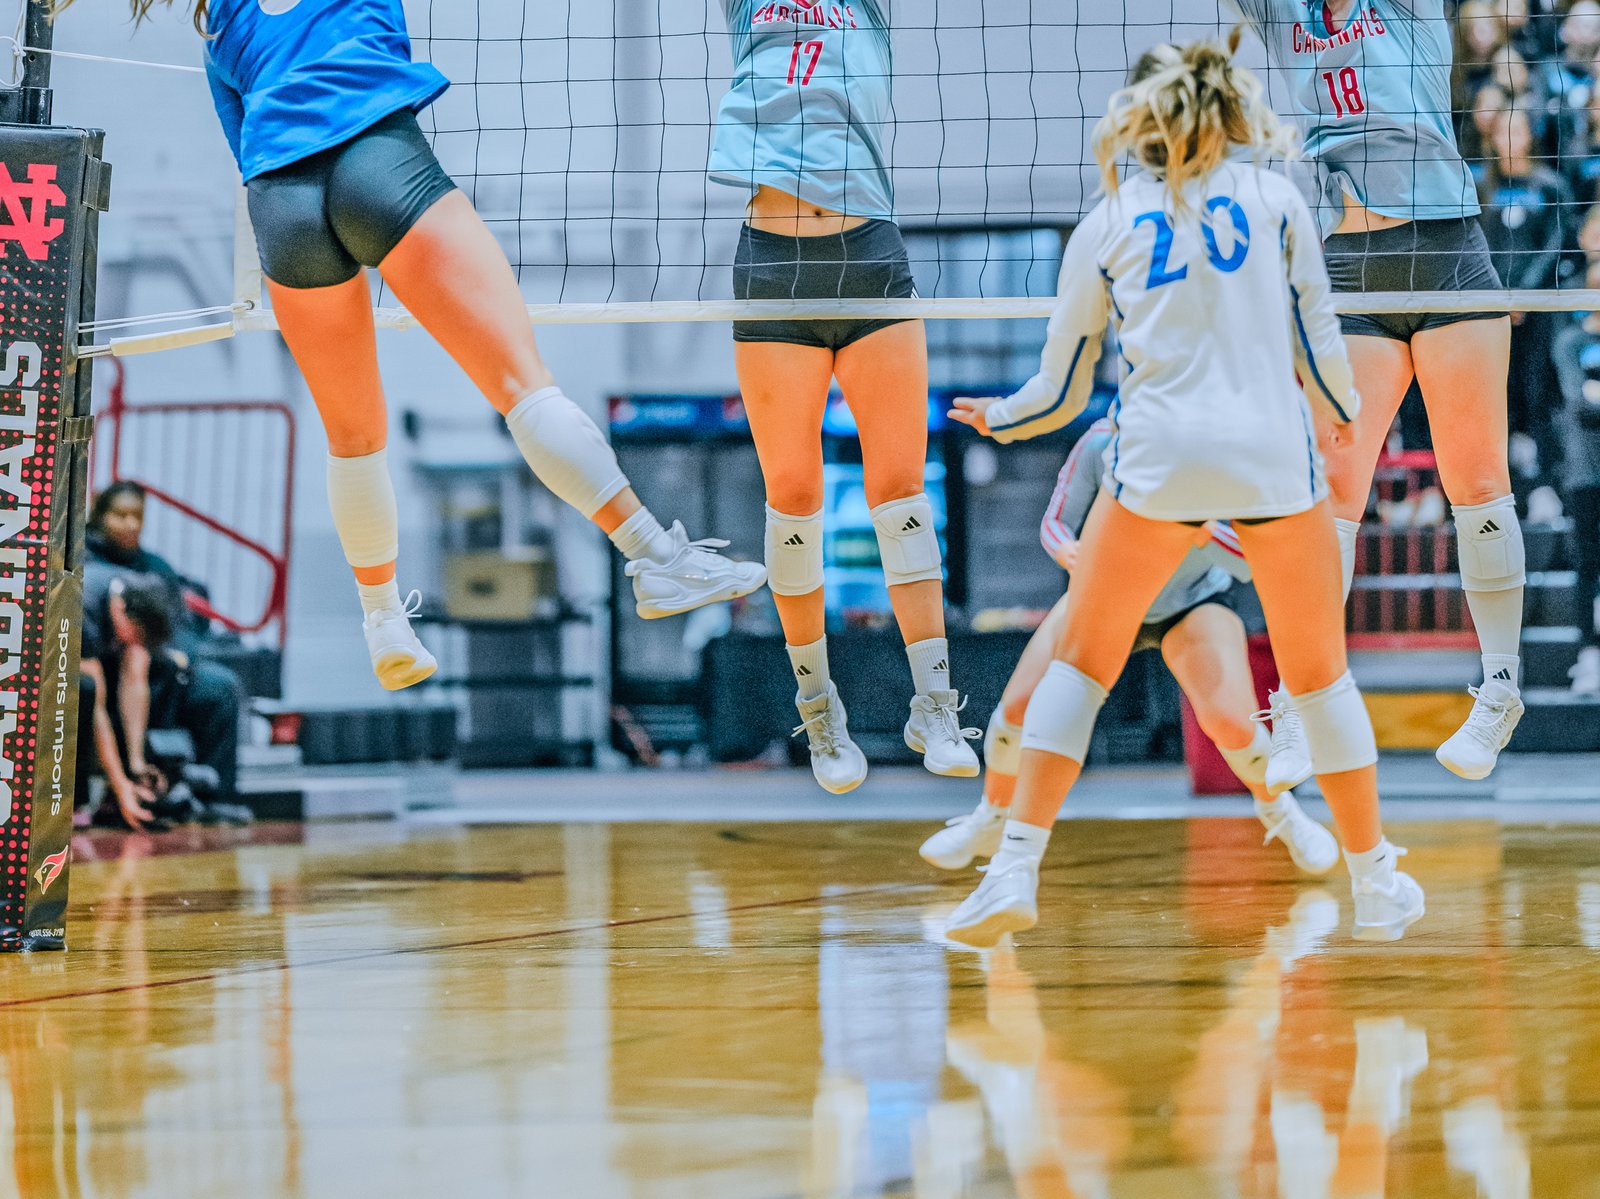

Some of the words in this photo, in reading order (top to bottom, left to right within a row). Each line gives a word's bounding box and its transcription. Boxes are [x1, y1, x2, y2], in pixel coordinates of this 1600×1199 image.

[786, 40, 823, 86] 17
[1322, 66, 1365, 118] 18
[1132, 195, 1250, 290] 20
[56, 618, 70, 705] sports
[51, 709, 65, 816] imports
